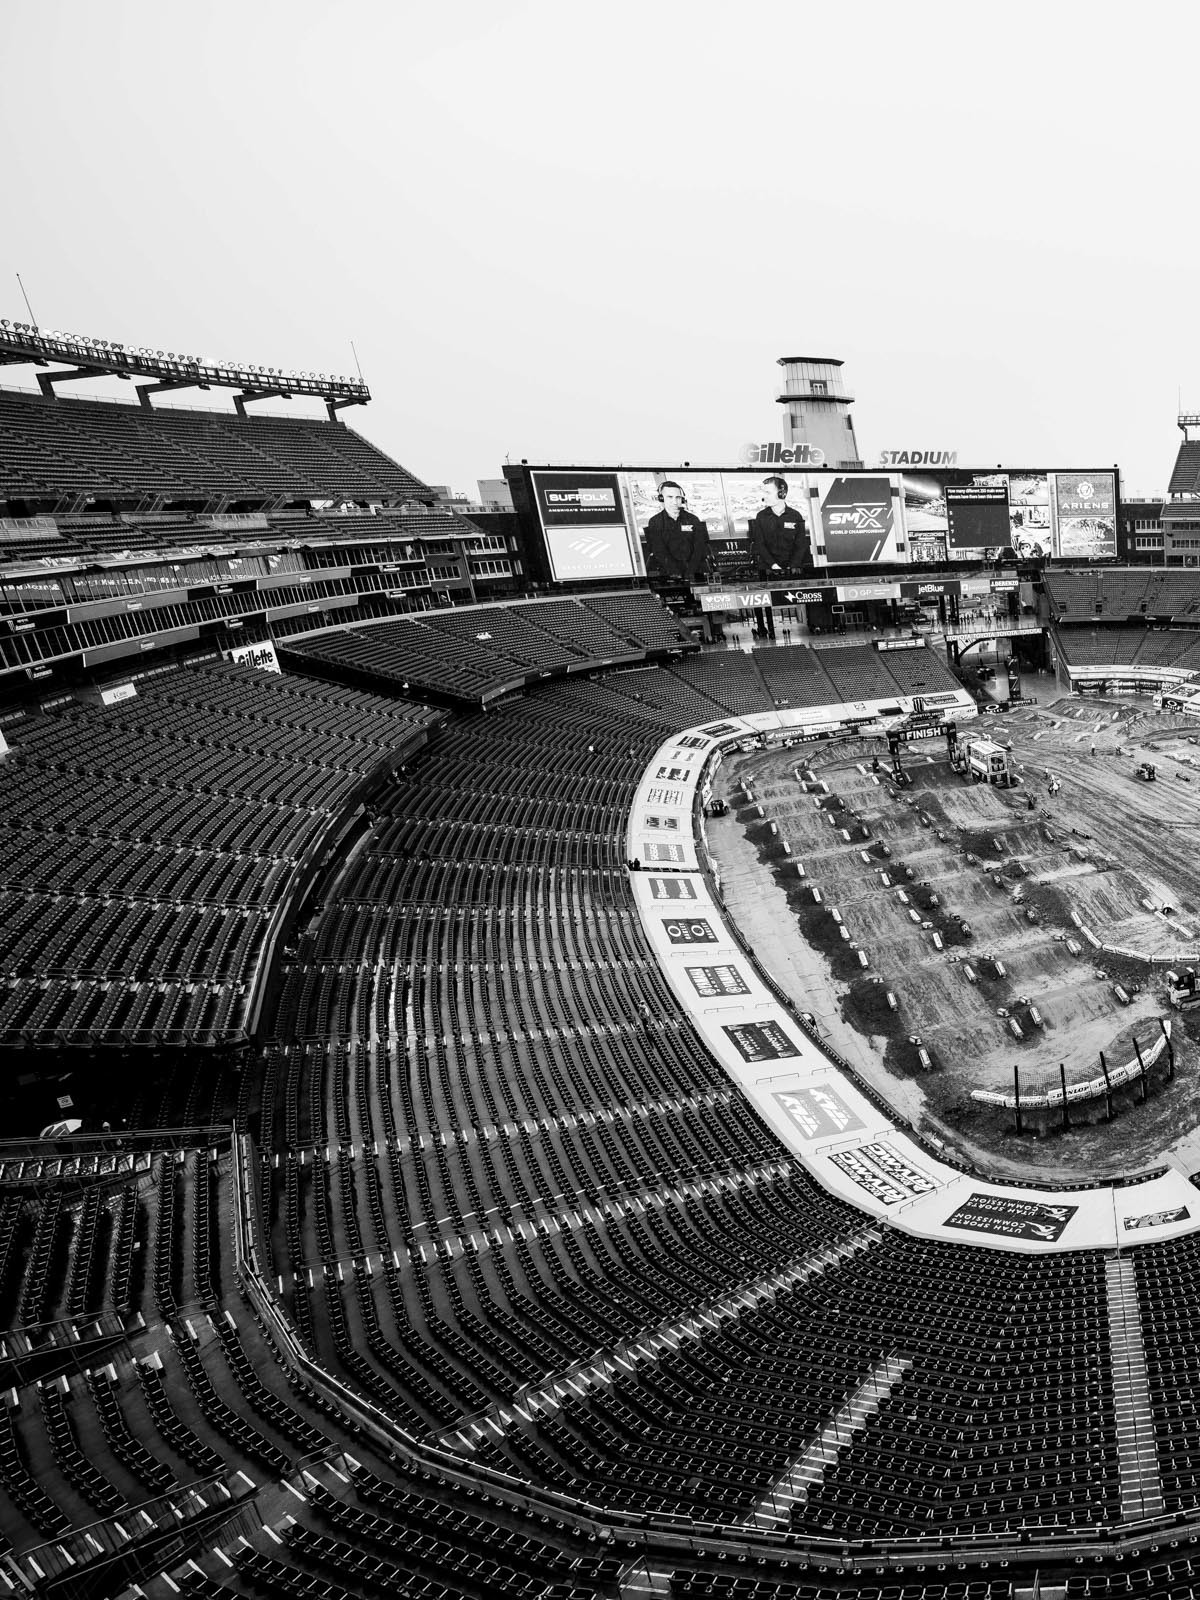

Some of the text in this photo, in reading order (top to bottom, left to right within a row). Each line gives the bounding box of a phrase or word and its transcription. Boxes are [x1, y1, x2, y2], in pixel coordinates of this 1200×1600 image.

[741, 442, 824, 464] Gillette
[880, 451, 958, 465] STADIUM
[548, 493, 609, 502] SUFFOLK
[828, 507, 883, 528] SMX
[795, 591, 822, 599] CROSS
[918, 584, 945, 595] jetBlue
[738, 594, 771, 606] VISA
[906, 727, 941, 740] FINISH
[1056, 1085, 1089, 1098] DNLOP
[778, 1094, 818, 1137] FLY
[808, 1088, 849, 1131] FLY
[966, 1201, 1036, 1217] UTAH SPORTS
[971, 1196, 1039, 1212] COMMISSION
[950, 1217, 1022, 1234] UTAH SPORTS
[955, 1213, 1026, 1229] COMMISSION
